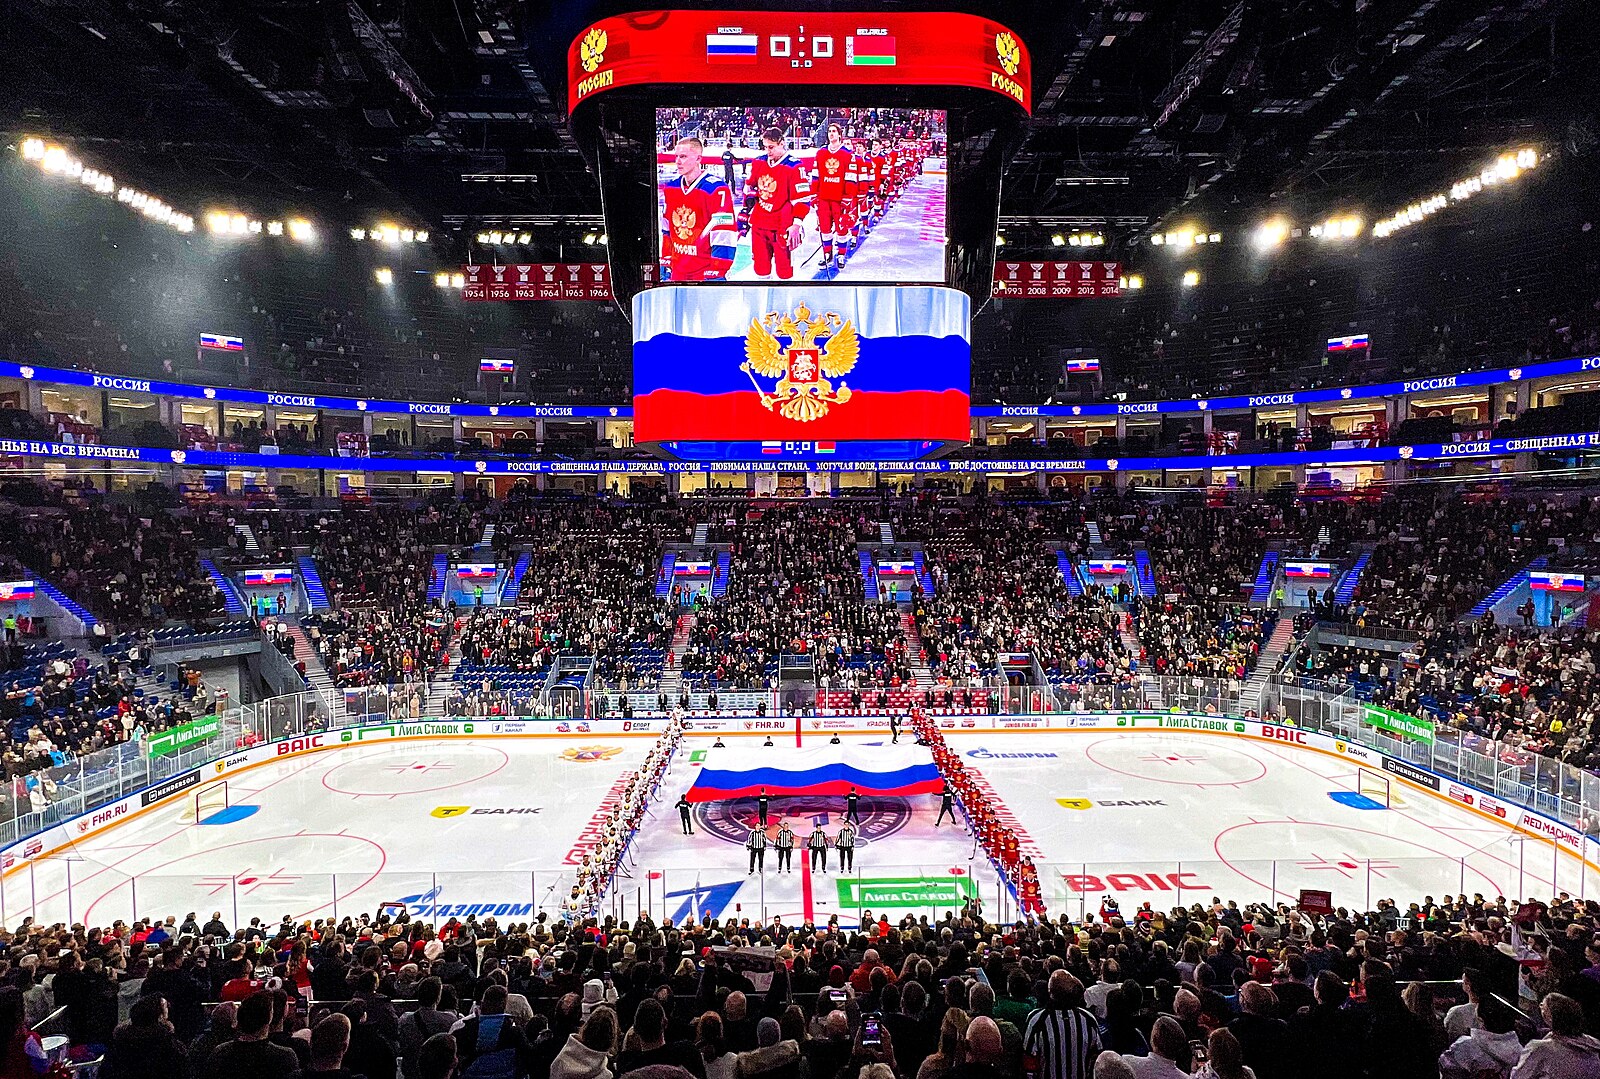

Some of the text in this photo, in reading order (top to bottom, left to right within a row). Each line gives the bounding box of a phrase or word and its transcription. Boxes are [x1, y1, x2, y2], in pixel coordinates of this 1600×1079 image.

[577, 69, 613, 99] РОССИЯ
[991, 71, 1024, 102] РОССИЯ
[718, 190, 726, 207] 7
[465, 290, 484, 298] 1954
[490, 289, 509, 298] 1956
[515, 289, 534, 298] 1963
[540, 289, 559, 298] 1964
[565, 289, 584, 298] 1965
[589, 289, 609, 298] 1966
[1004, 287, 1023, 295] 1993
[1027, 287, 1046, 295] 2008
[1052, 287, 1071, 295] 2009
[1077, 287, 1095, 295] 2012
[1101, 287, 1119, 295] 2014
[93, 375, 151, 392] РОССИЯ
[1403, 376, 1457, 392] РОССИЯ
[268, 394, 316, 407] РОССИЯ
[1249, 393, 1294, 406] РОССИЯ
[409, 403, 450, 414] РОССИЯ
[535, 407, 572, 416] РОССИЯ
[1002, 406, 1038, 416] РОССИЯ
[1117, 403, 1158, 414] РОССИЯ
[1441, 442, 1491, 454] РОССИЯ
[1506, 434, 1586, 450] СВЯЩЕННАЯ
[30, 442, 49, 454] НА
[52, 444, 76, 456] ВСЕ
[78, 445, 140, 459] ВРЕМЕНА!
[507, 462, 541, 471] РОССИЯ
[550, 462, 600, 472] СВЯЩЕННАЯ
[601, 462, 625, 471] НАША
[668, 462, 701, 471] РОССИЯ
[710, 462, 750, 471] ЛЮБИМАЯ
[752, 462, 776, 471] НАША
[777, 462, 810, 471] СТРАНА.
[816, 462, 854, 471] МОГУЧАЯ
[854, 462, 877, 471] ВОЛЯ,
[878, 461, 914, 471] ВЕЛИКАЯ
[914, 461, 941, 470] СЛАВА
[950, 460, 970, 470] ТВОЁ
[970, 461, 1017, 471] ДОСТОЯНЬЕ
[1017, 461, 1029, 470] НА
[1030, 461, 1045, 470] ВСЕ
[1046, 460, 1086, 470] ВРЕМЕНА!
[755, 721, 785, 729] FHR.RU
[1261, 725, 1307, 744] BAIC
[277, 735, 324, 755] BAIC
[1347, 747, 1368, 759] БАНК
[226, 755, 248, 767] БАНК
[1395, 764, 1434, 785] HENDERSON
[156, 775, 195, 797] HENDERSON
[1096, 799, 1169, 808] БАНК
[92, 803, 128, 826] FHR.RU
[470, 807, 545, 815] БАНК
[1523, 815, 1579, 848] RED MACHINE
[1060, 872, 1213, 892] BAIC
[424, 902, 533, 917] ГАЗПРОМ
